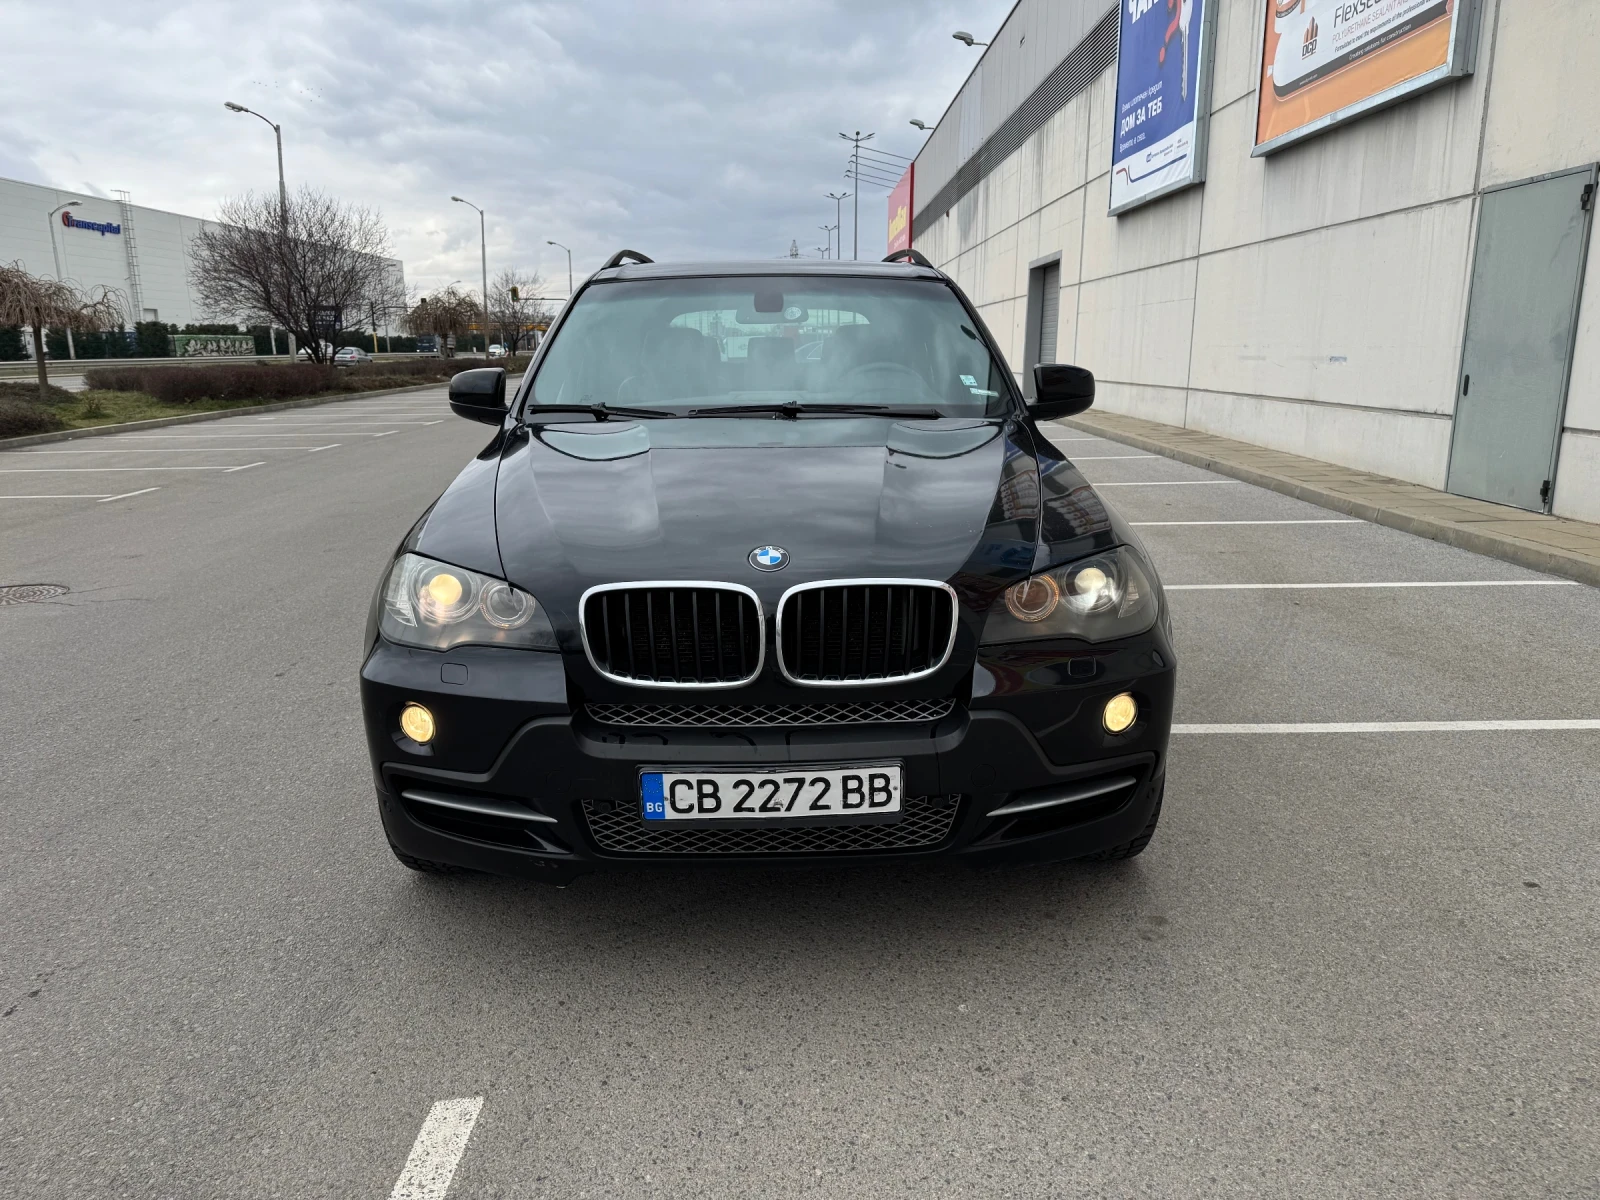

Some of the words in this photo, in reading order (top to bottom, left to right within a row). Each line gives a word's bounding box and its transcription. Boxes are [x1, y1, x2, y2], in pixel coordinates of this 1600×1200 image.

[1348, 48, 1364, 60] Creating
[1364, 41, 1380, 52] solutions
[1386, 23, 1412, 40] construction
[1120, 112, 1136, 138] ДОМ
[1136, 106, 1146, 126] ЗА
[1147, 96, 1163, 119] ТЕБ
[67, 214, 121, 236] Transcapital
[646, 802, 663, 813] BG
[669, 779, 722, 814] CB
[732, 777, 831, 813] 2272
[842, 773, 893, 809] BB
